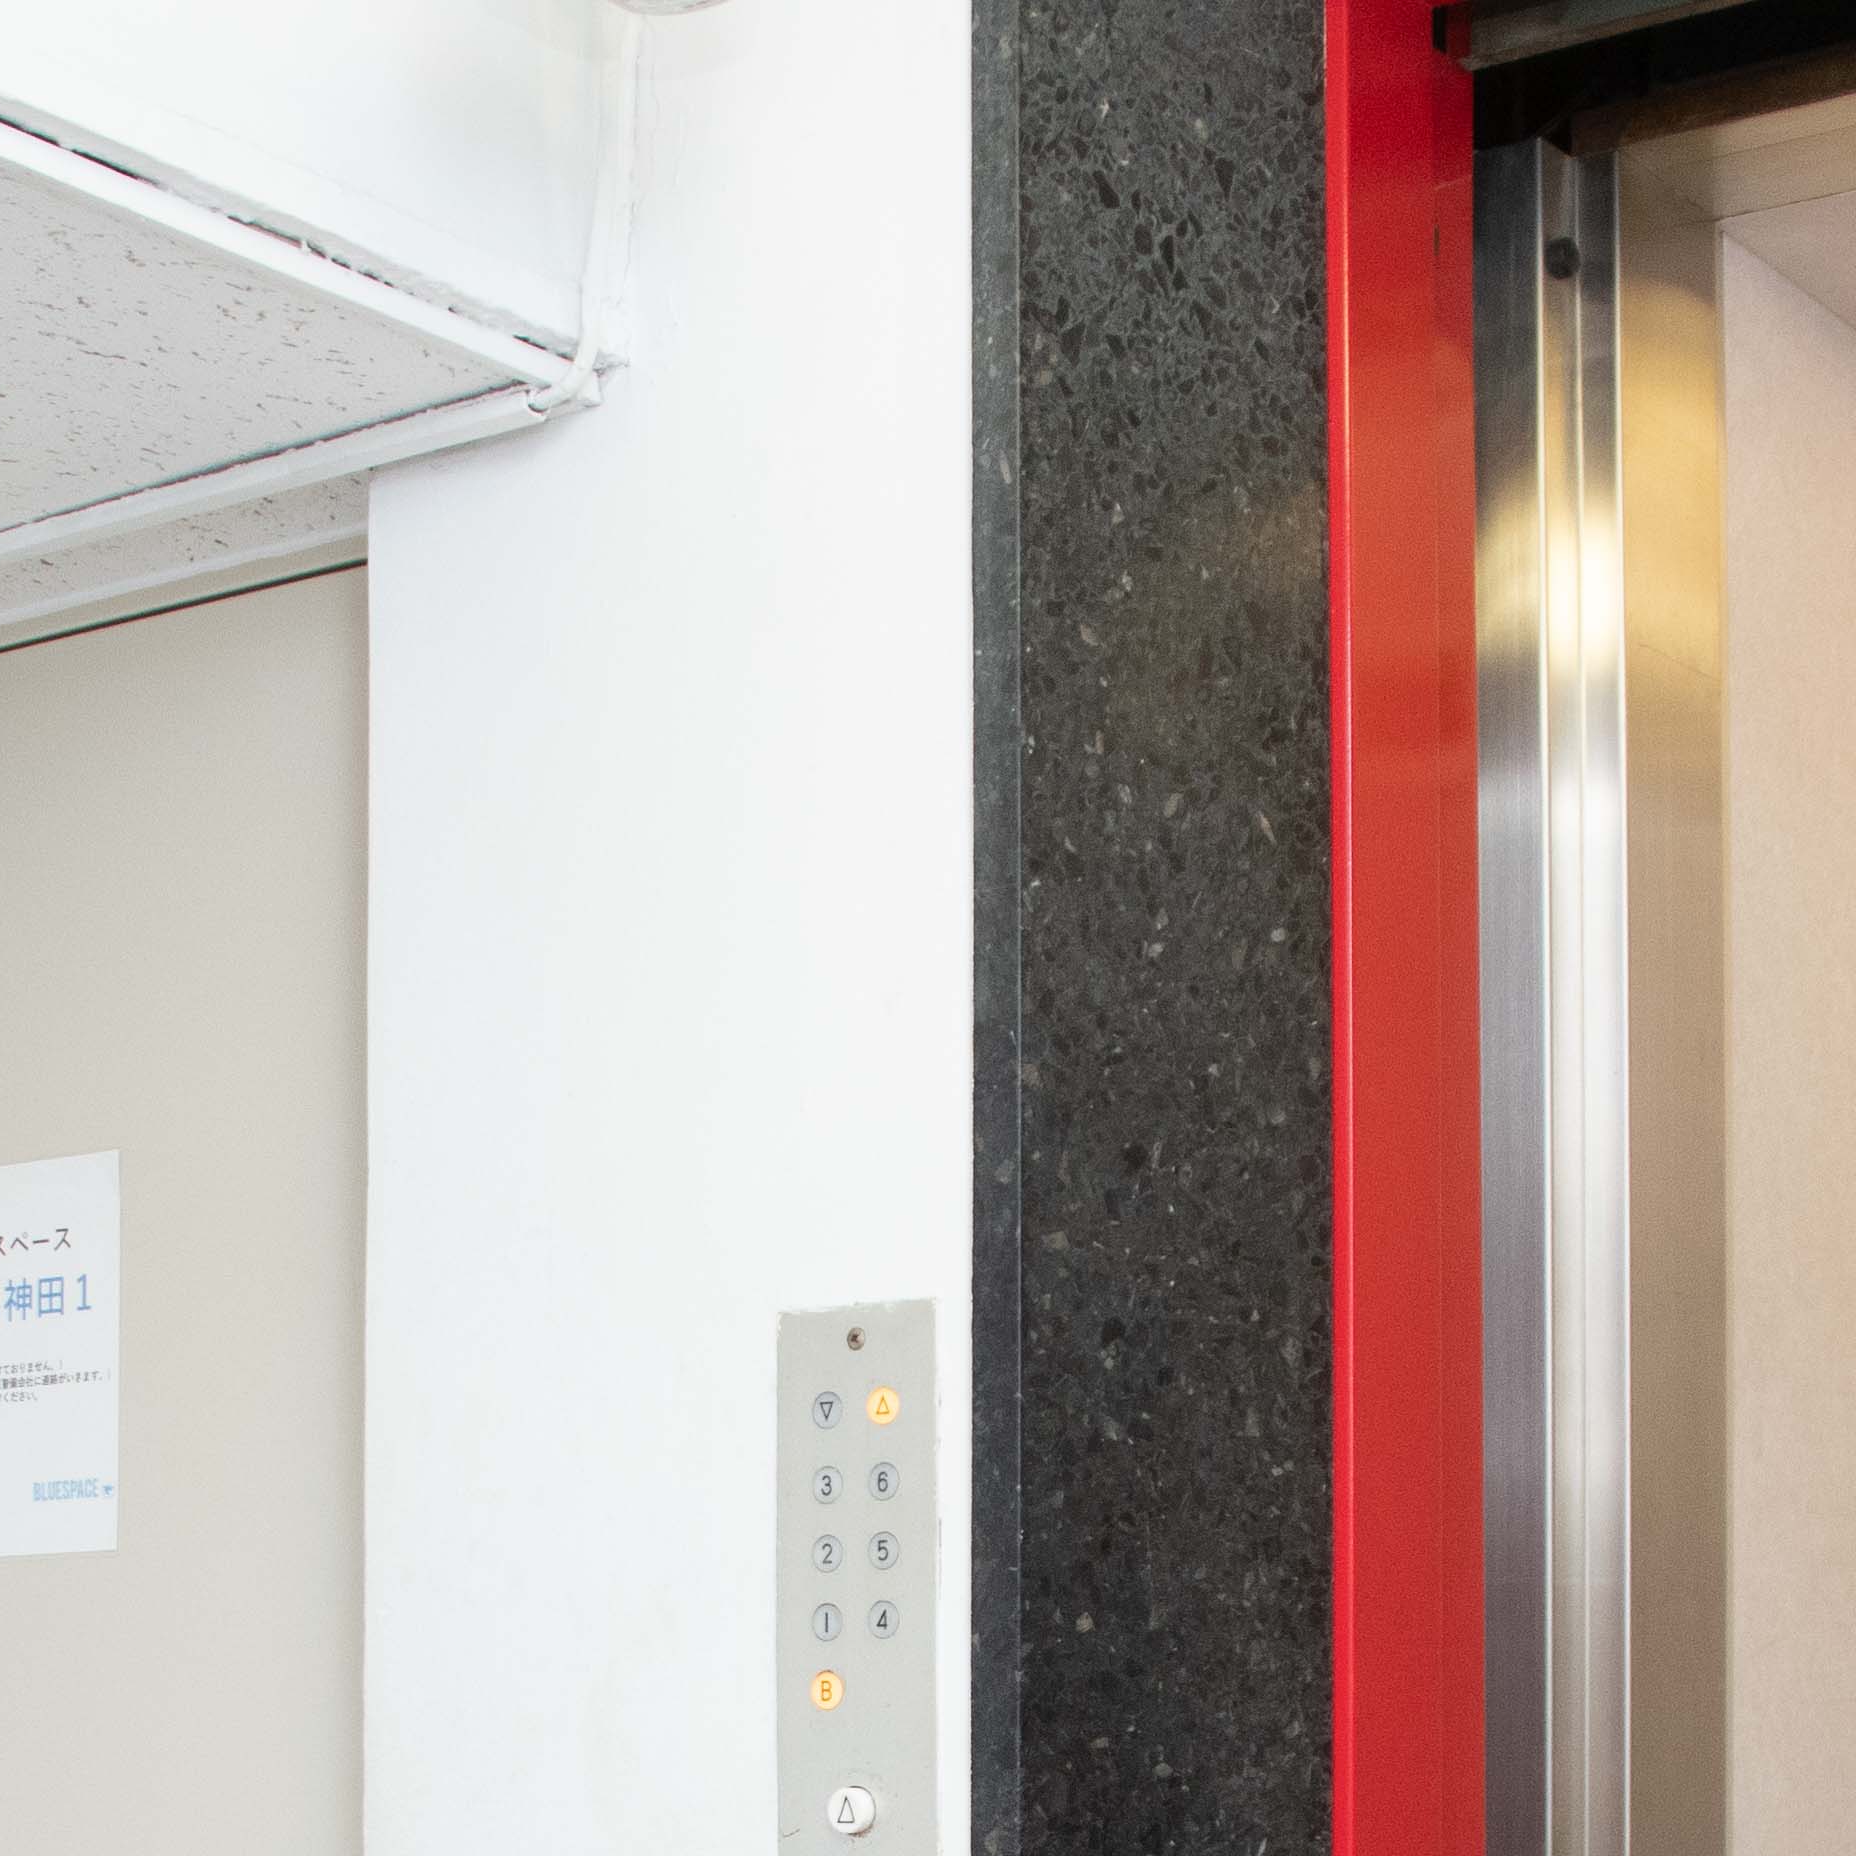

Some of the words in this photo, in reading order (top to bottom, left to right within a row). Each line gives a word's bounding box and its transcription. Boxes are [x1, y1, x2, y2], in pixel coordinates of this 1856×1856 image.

[33, 1478, 100, 1501] BLUESPACE
[821, 1475, 833, 1495] 3
[878, 1471, 889, 1491] 6
[821, 1544, 833, 1564] 2
[877, 1540, 889, 1561] 5
[877, 1610, 889, 1630] 4
[821, 1681, 833, 1701] B
